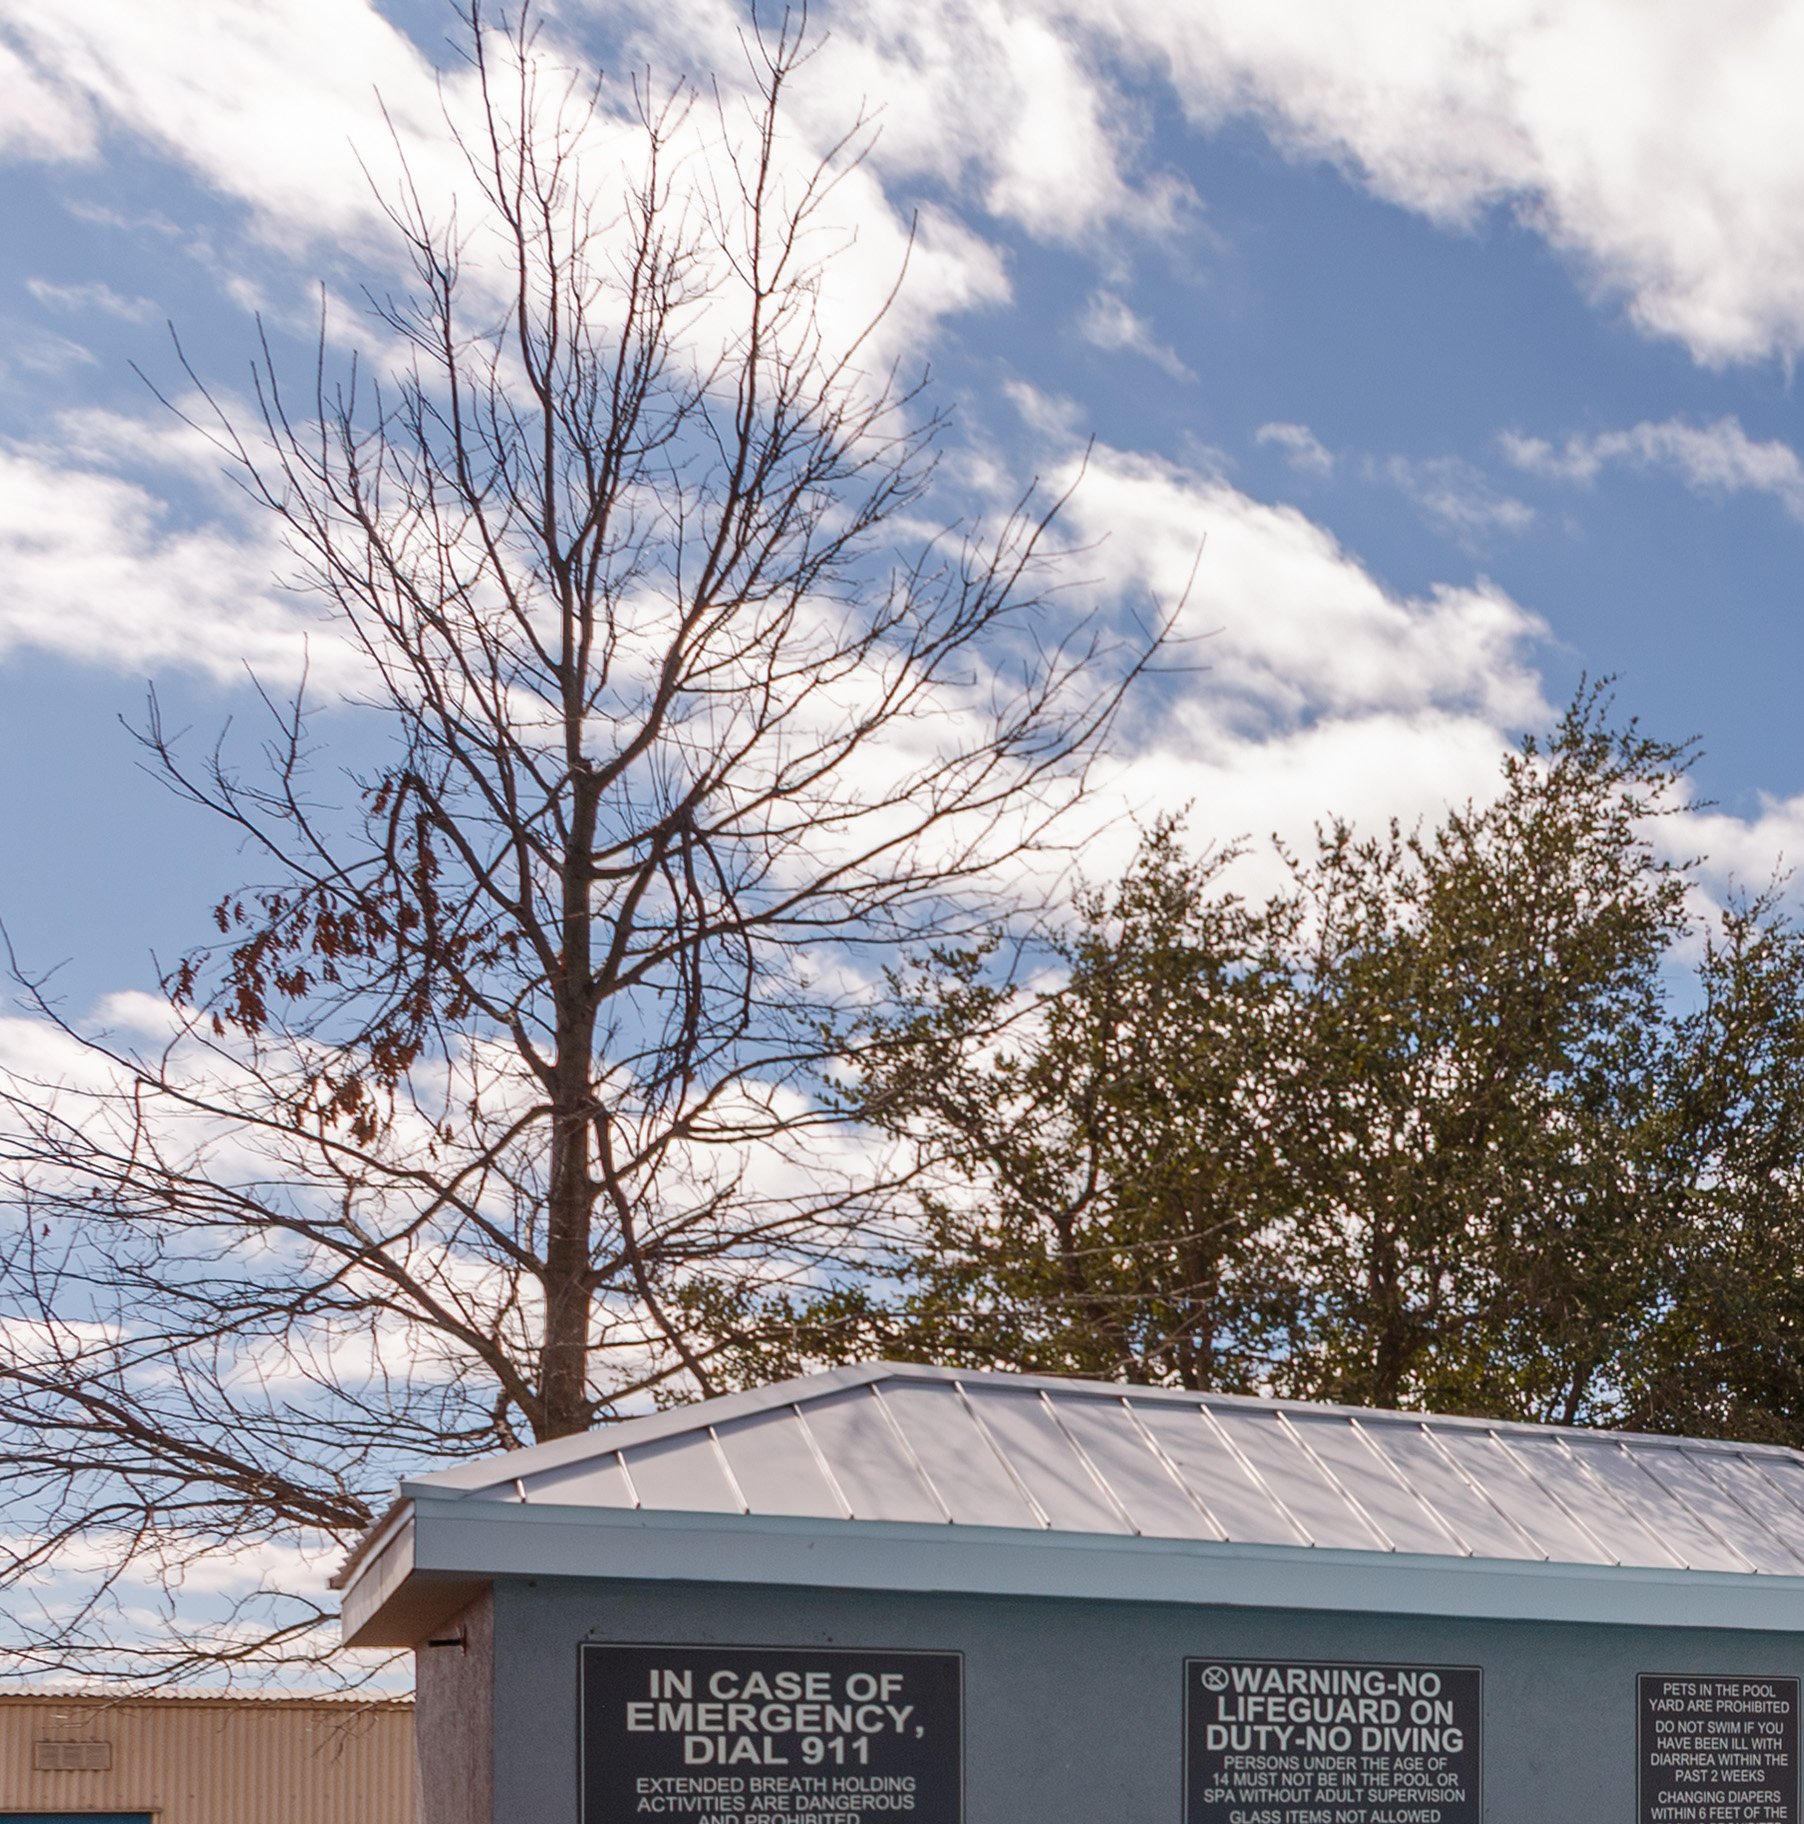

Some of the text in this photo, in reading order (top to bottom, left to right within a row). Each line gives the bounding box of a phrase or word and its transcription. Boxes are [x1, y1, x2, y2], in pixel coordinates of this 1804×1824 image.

[650, 1669, 903, 1701] IN CASE OF
[1231, 1667, 1441, 1697] WARNING-NO
[1663, 1683, 1776, 1697] PETS IN THE POOL
[1218, 1696, 1453, 1725] LIFEGUARD ON
[1649, 1699, 1789, 1713] YARD ARE PROHIBITED
[626, 1702, 924, 1739] EMERGENCY,
[1656, 1721, 1783, 1734] DO NOT SWIM IF YOU
[1207, 1725, 1464, 1752] DUTY-NO DIVING
[1657, 1738, 1782, 1750] HAVE BEEN ILL WITH
[684, 1736, 869, 1765] DIAL 911
[1224, 1756, 1447, 1770] PERSONS UNDER THE AGE OF
[1651, 1753, 1788, 1766] DIARRHEA WITHIN THE
[1213, 1773, 1458, 1786] 14 MUST NOT BE IN THE POOL OR
[1675, 1770, 1765, 1782] PAST 2 WEEKS
[636, 1776, 915, 1793] EXTENDED BREATH HOLDING
[1204, 1789, 1465, 1802] SPA WITHOUT ADULT SUPERVISION
[1658, 1791, 1781, 1803] CHANGING DIAPERS
[637, 1795, 914, 1812] ACTIVITIES ARE DANGEROUS
[1229, 1810, 1440, 1824] GLASS ITEMS NOT ALLOWED
[1651, 1806, 1787, 1819] WITHIN 6 FEET OF THE
